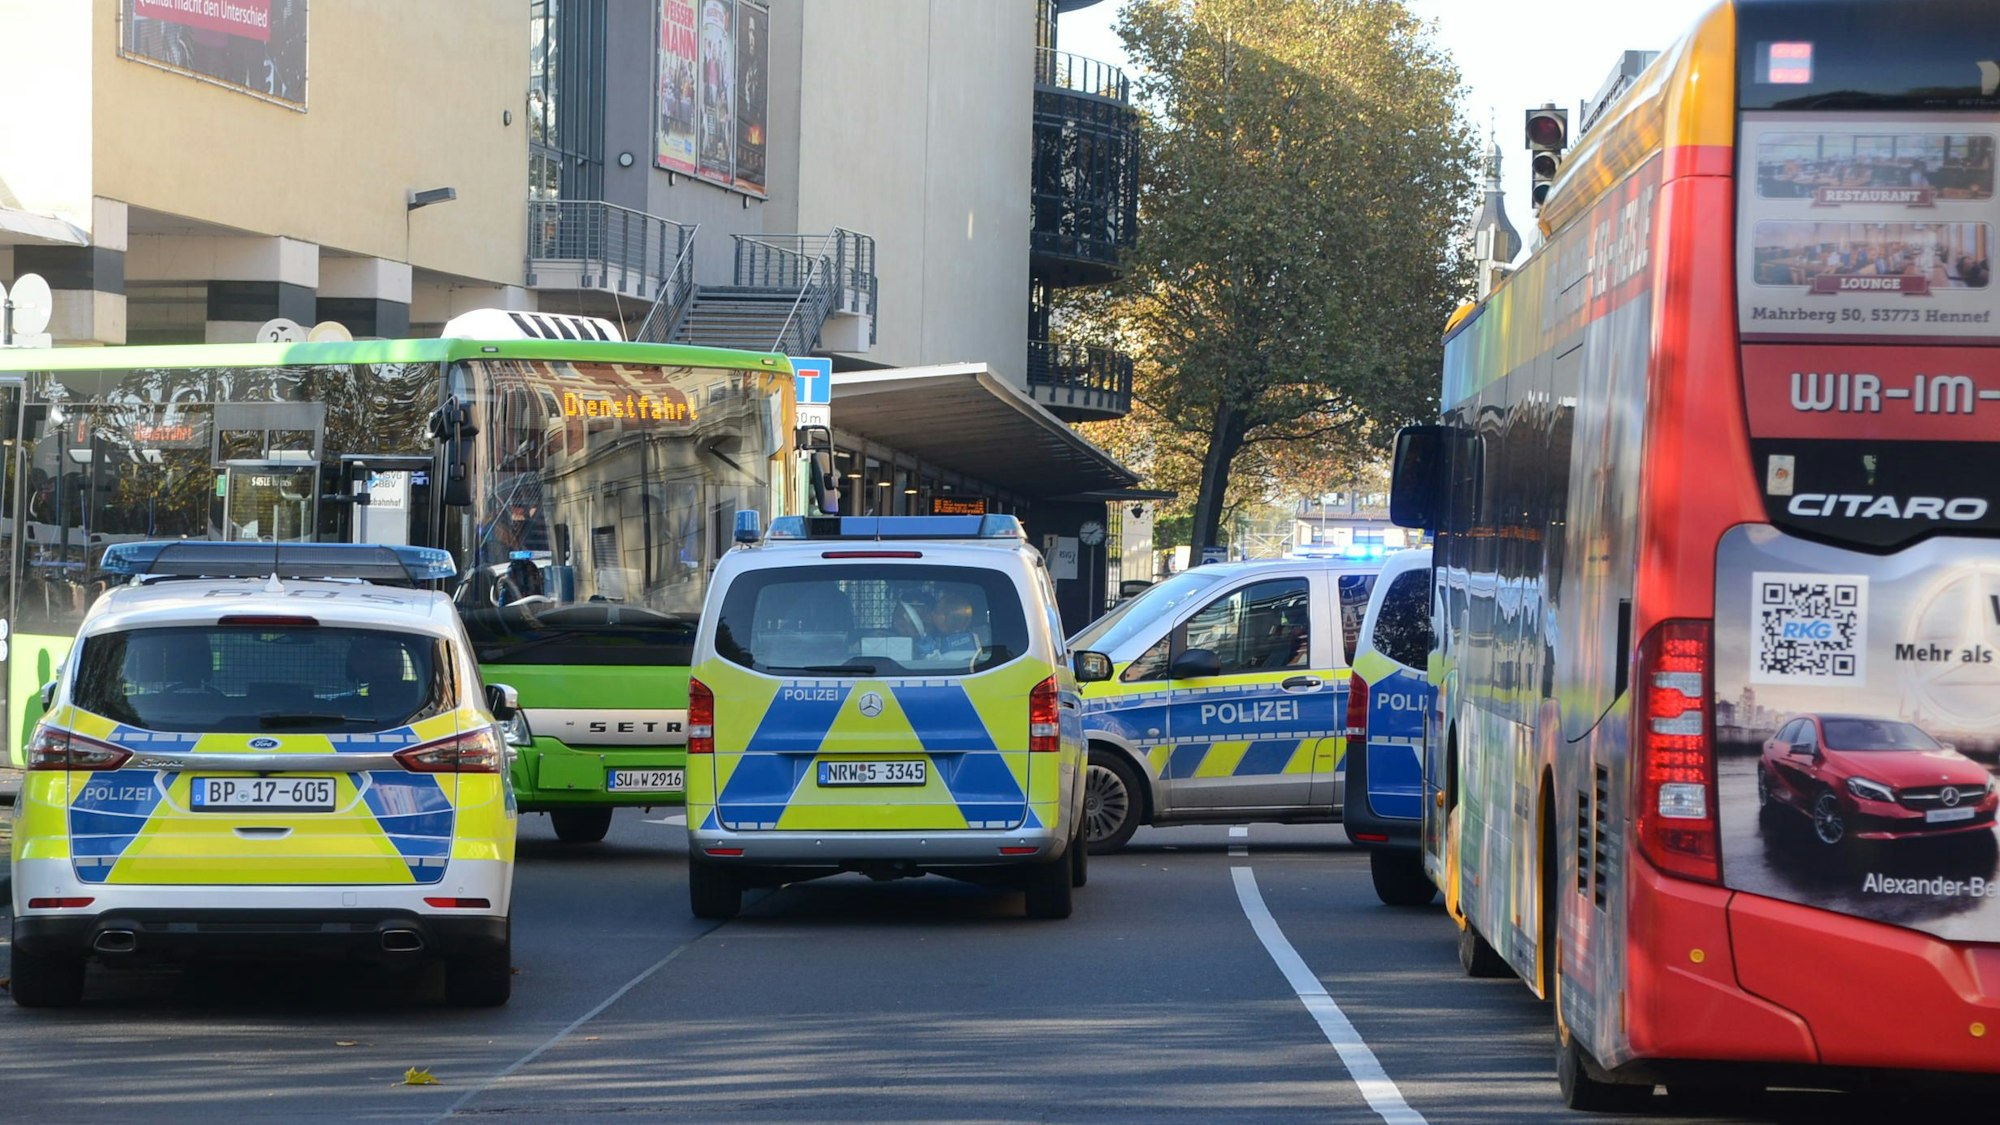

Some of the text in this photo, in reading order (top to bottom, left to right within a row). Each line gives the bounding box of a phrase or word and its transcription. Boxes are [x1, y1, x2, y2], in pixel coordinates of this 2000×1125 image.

[203, 0, 219, 18] den
[221, 6, 268, 28] Unterschied
[662, 20, 697, 62] MANN
[1825, 190, 1921, 202] RESTAURANT
[1840, 278, 1901, 290] LOUNGE
[1752, 307, 1990, 324] Mahrberg 50, 53773 Hennef
[564, 392, 698, 420] Dienstfahrt
[810, 414, 822, 424] m
[1788, 493, 1988, 521] CITARO
[1048, 536, 1054, 547] 1
[1783, 620, 1834, 639] RKG
[1895, 643, 1993, 663] Mehr als
[784, 689, 839, 701] POLIZEI
[1201, 700, 1299, 724] POLIZEI
[254, 738, 274, 748] Ford
[616, 773, 632, 787] SU
[828, 763, 924, 781] NRW 5-3345
[84, 787, 152, 801] POLIZEI
[210, 782, 235, 803] BP
[252, 781, 329, 803] 17-605
